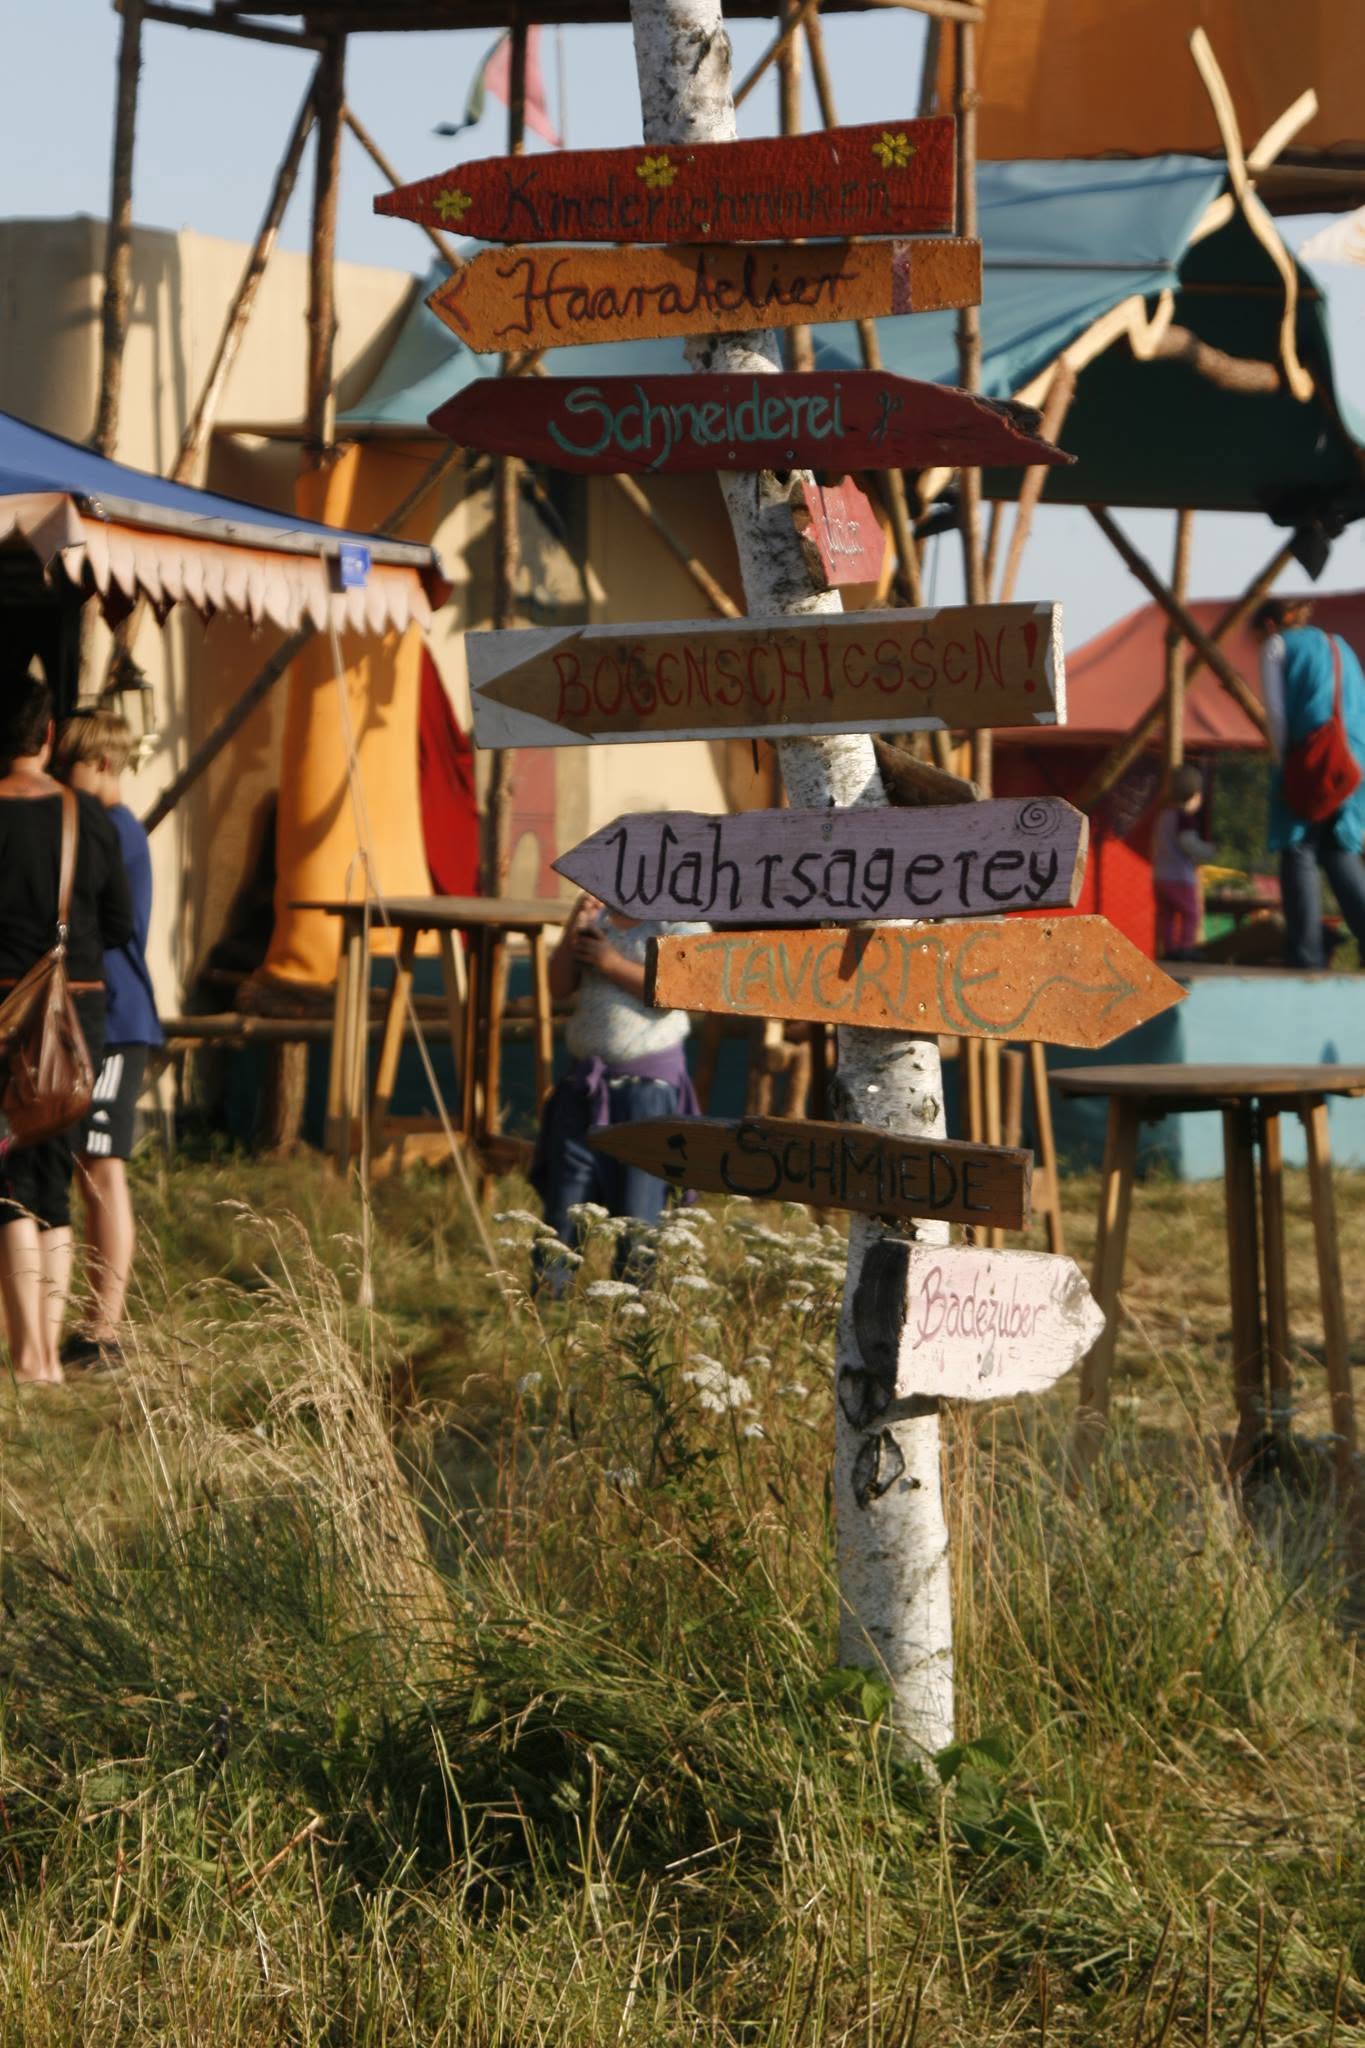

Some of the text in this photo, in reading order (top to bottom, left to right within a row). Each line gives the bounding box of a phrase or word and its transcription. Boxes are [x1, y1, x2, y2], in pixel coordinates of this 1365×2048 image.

[494, 255, 860, 336] Haaratelier
[548, 381, 846, 468] Schneiderei
[605, 823, 1059, 912] Wahrsagerey
[720, 1124, 993, 1212] SCHMIEDE
[911, 1266, 1047, 1351] Badezuber
